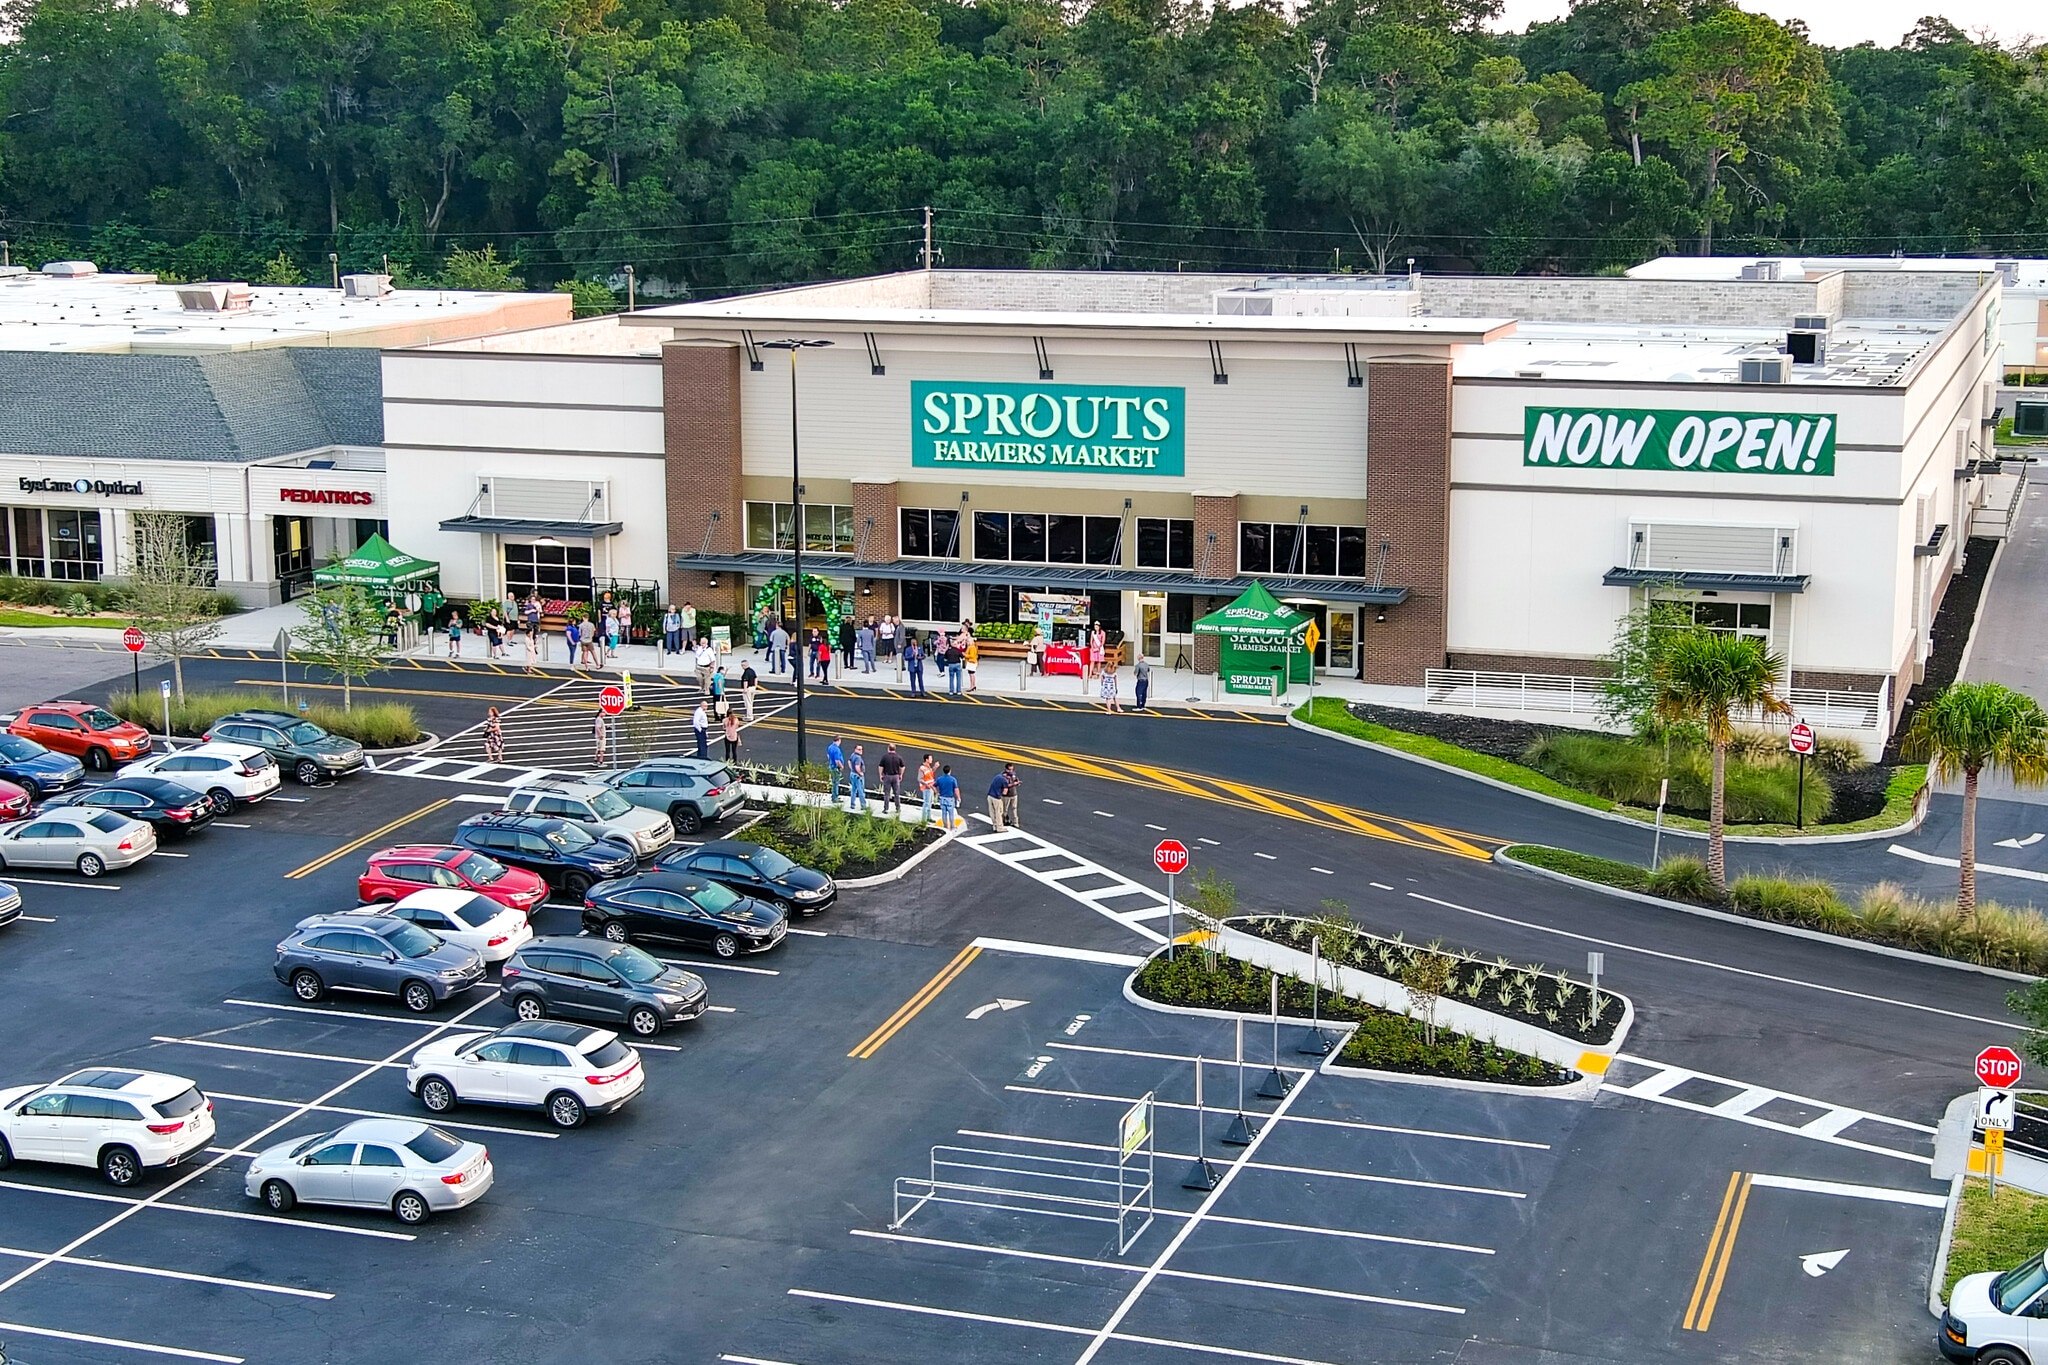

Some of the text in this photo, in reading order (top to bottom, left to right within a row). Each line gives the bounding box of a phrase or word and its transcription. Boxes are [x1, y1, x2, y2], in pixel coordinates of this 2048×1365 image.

[923, 392, 1171, 441] SPROUTS
[1528, 412, 1832, 473] NOW OPEN!
[934, 440, 1159, 468] FARMERS MARKET
[19, 477, 144, 498] EyeCare Optical
[280, 488, 373, 506] PEDIATRICS
[124, 634, 144, 645] STOP
[1233, 643, 1268, 652] FARMERS
[601, 695, 624, 707] STOP
[1157, 850, 1186, 864] STOP
[1979, 1059, 2018, 1076] STOP
[1981, 1117, 2009, 1128] ONLY
